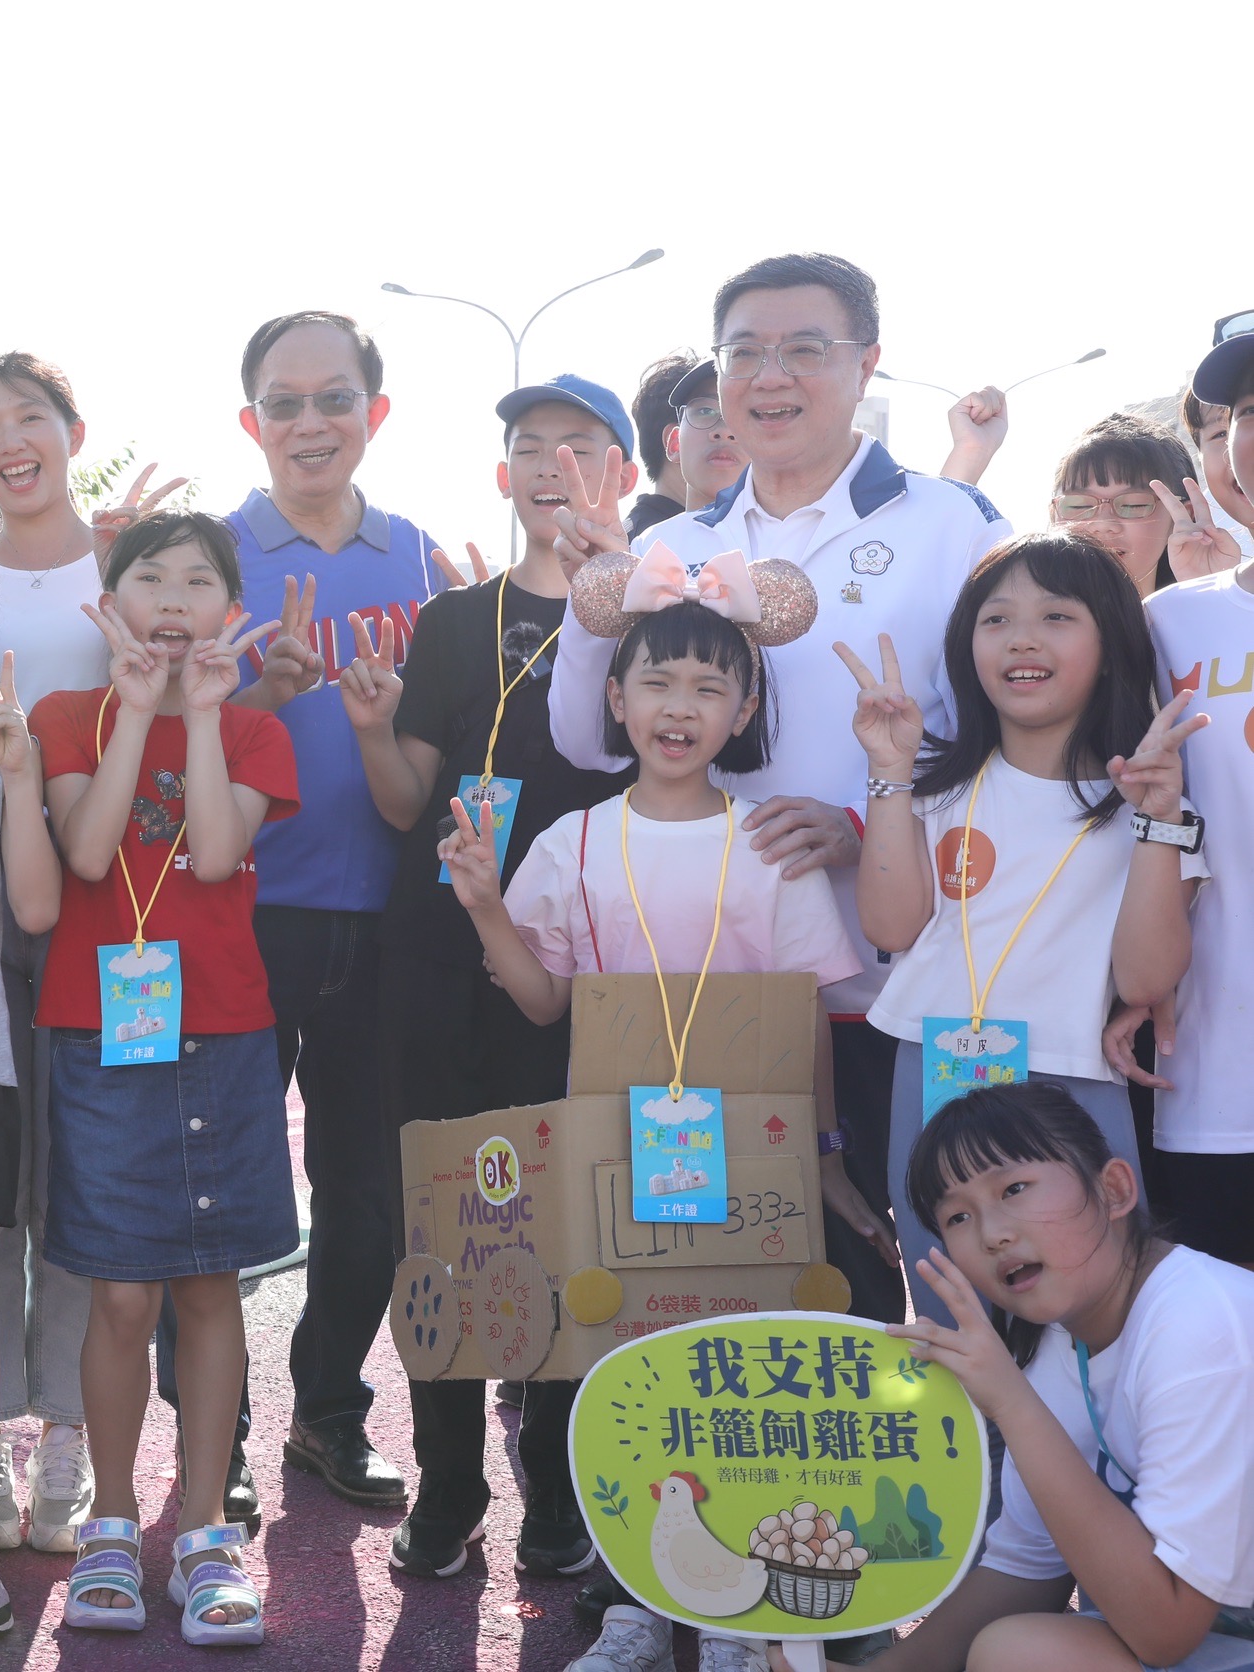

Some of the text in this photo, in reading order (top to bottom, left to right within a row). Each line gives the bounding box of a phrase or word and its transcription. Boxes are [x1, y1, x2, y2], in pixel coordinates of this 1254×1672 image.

[122, 1047, 155, 1060] 工作證
[538, 1138, 550, 1149] UP
[768, 1134, 786, 1144] UP
[433, 1173, 453, 1182] Home
[522, 1163, 547, 1175] Expert
[483, 1151, 513, 1190] OK
[458, 1191, 534, 1234] Magic
[659, 1204, 698, 1217] 工作證
[646, 1294, 758, 1314] 6袋裝 2000g
[687, 1336, 877, 1400] 我支持
